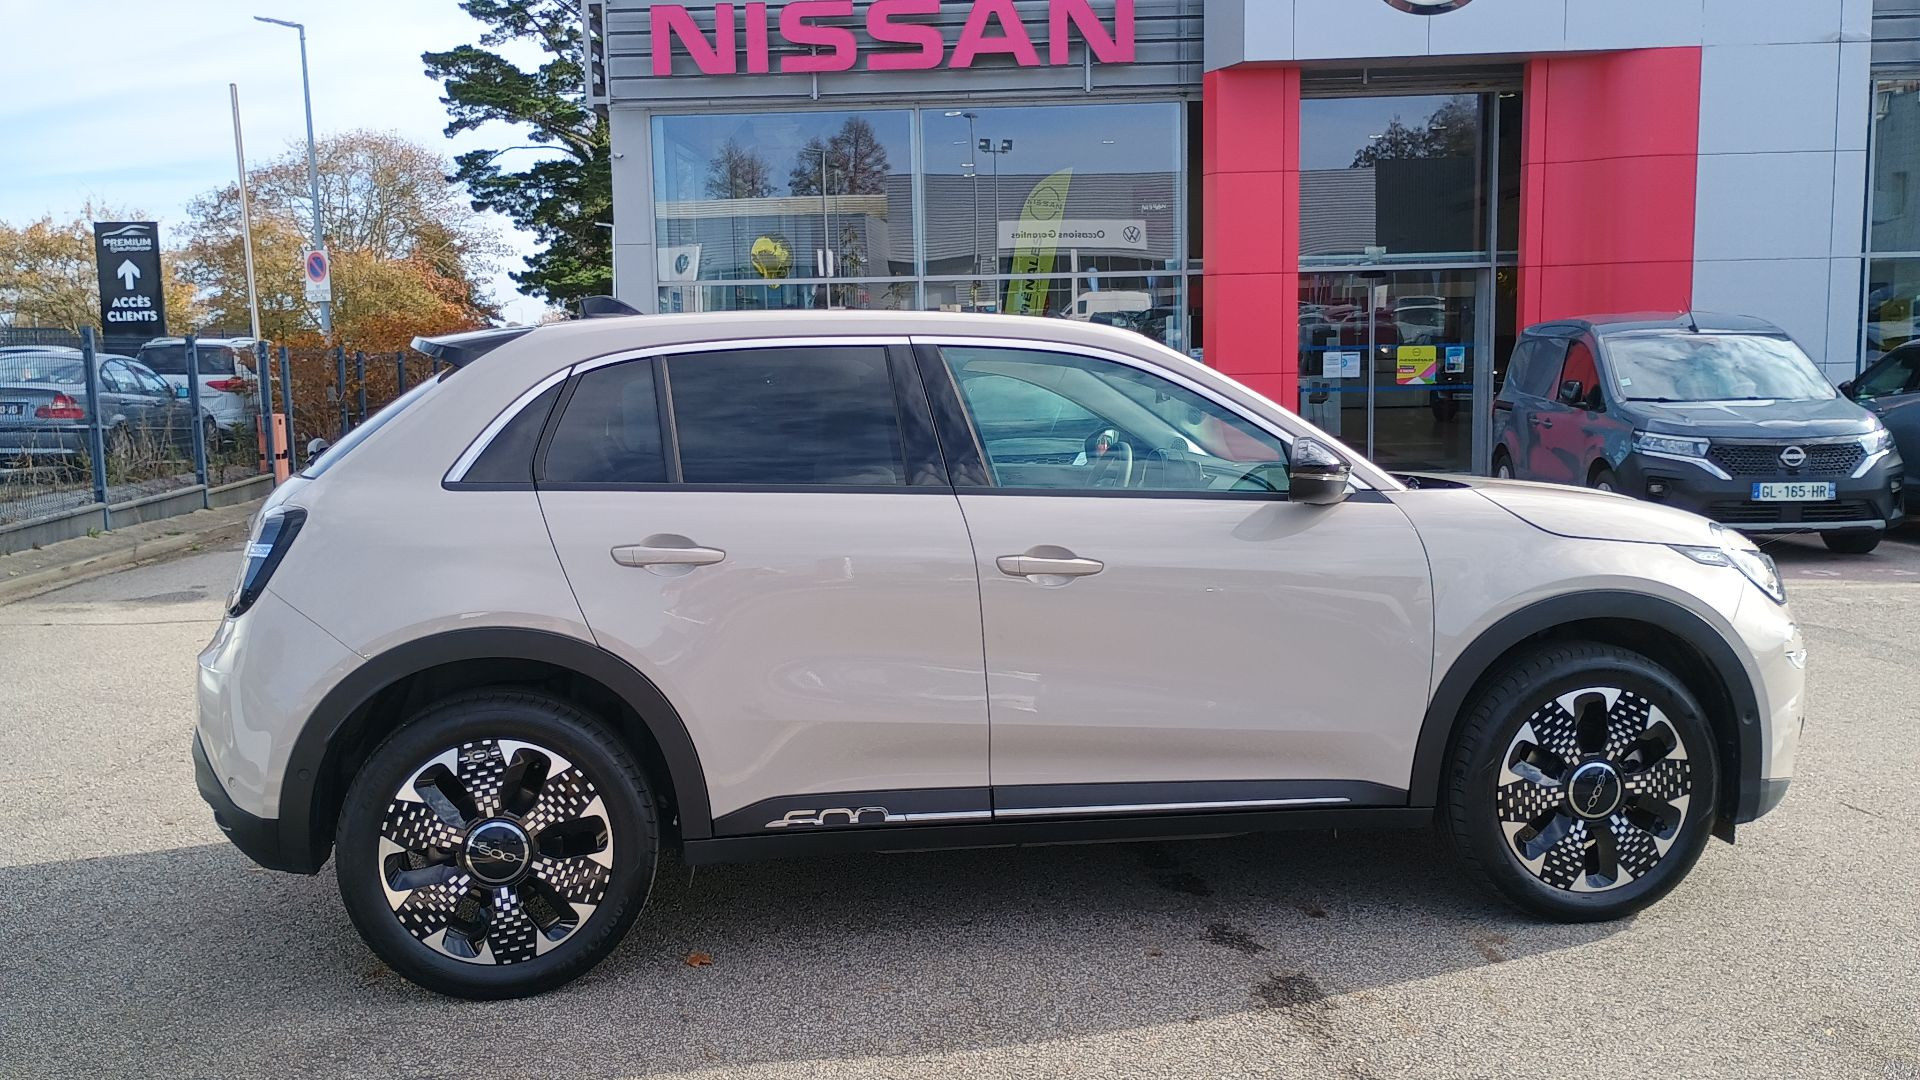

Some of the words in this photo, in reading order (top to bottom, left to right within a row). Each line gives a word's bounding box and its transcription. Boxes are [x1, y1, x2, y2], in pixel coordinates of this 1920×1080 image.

[650, 0, 1135, 76] NISSAN
[103, 238, 152, 247] PREMIUM
[111, 294, 152, 308] ACCÈS
[107, 310, 158, 322] CLIENTS
[1762, 485, 1827, 498] GL-165-HR
